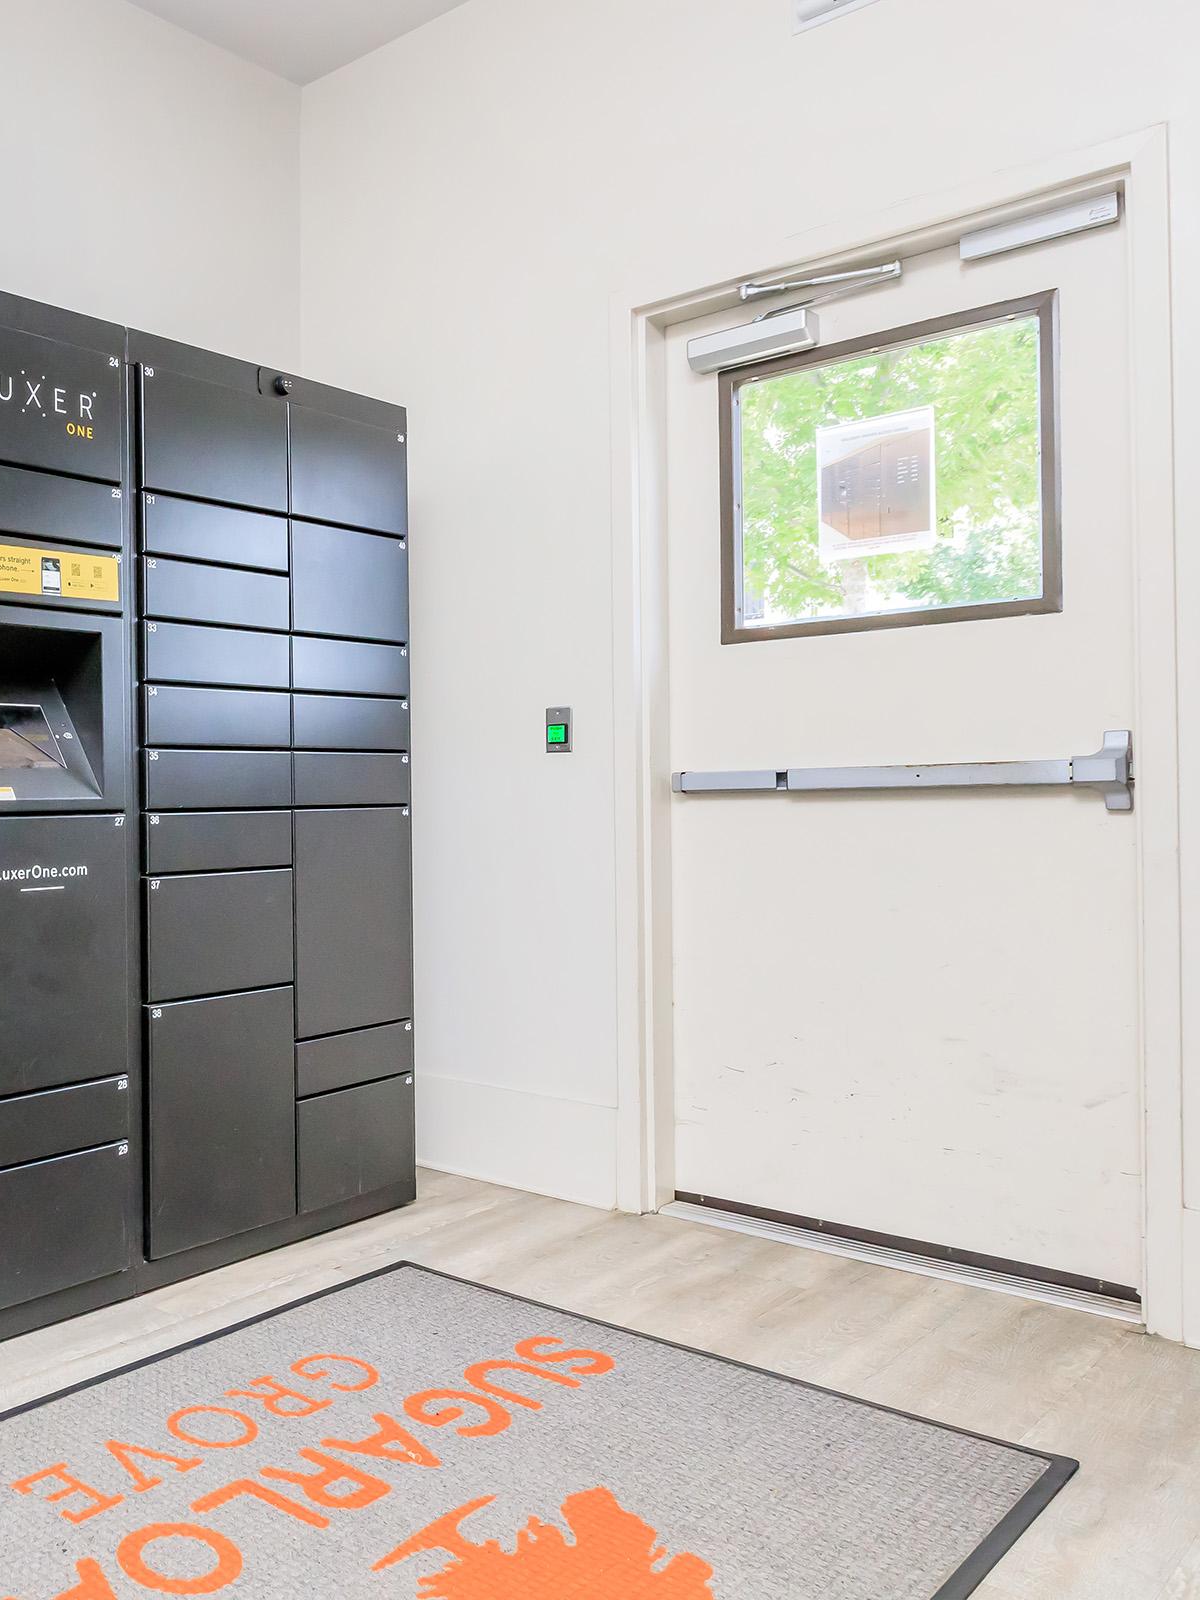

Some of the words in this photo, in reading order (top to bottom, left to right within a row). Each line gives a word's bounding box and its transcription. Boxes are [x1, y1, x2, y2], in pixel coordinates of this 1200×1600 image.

[110, 357, 119, 367] 24
[145, 367, 154, 377] 30
[66, 423, 93, 439] ONE
[112, 489, 122, 498] 25
[147, 495, 154, 504] 31
[7, 556, 31, 565] straight
[148, 559, 156, 568] 32
[148, 623, 156, 632] 33
[148, 688, 158, 697] 34
[150, 752, 158, 760] 35
[115, 817, 124, 826] 27
[150, 816, 159, 824] 36
[151, 881, 160, 889] 37
[153, 1009, 161, 1018] 38
[118, 1080, 127, 1089] 28
[119, 1145, 128, 1155] 29
[12, 1354, 378, 1523] GROVE
